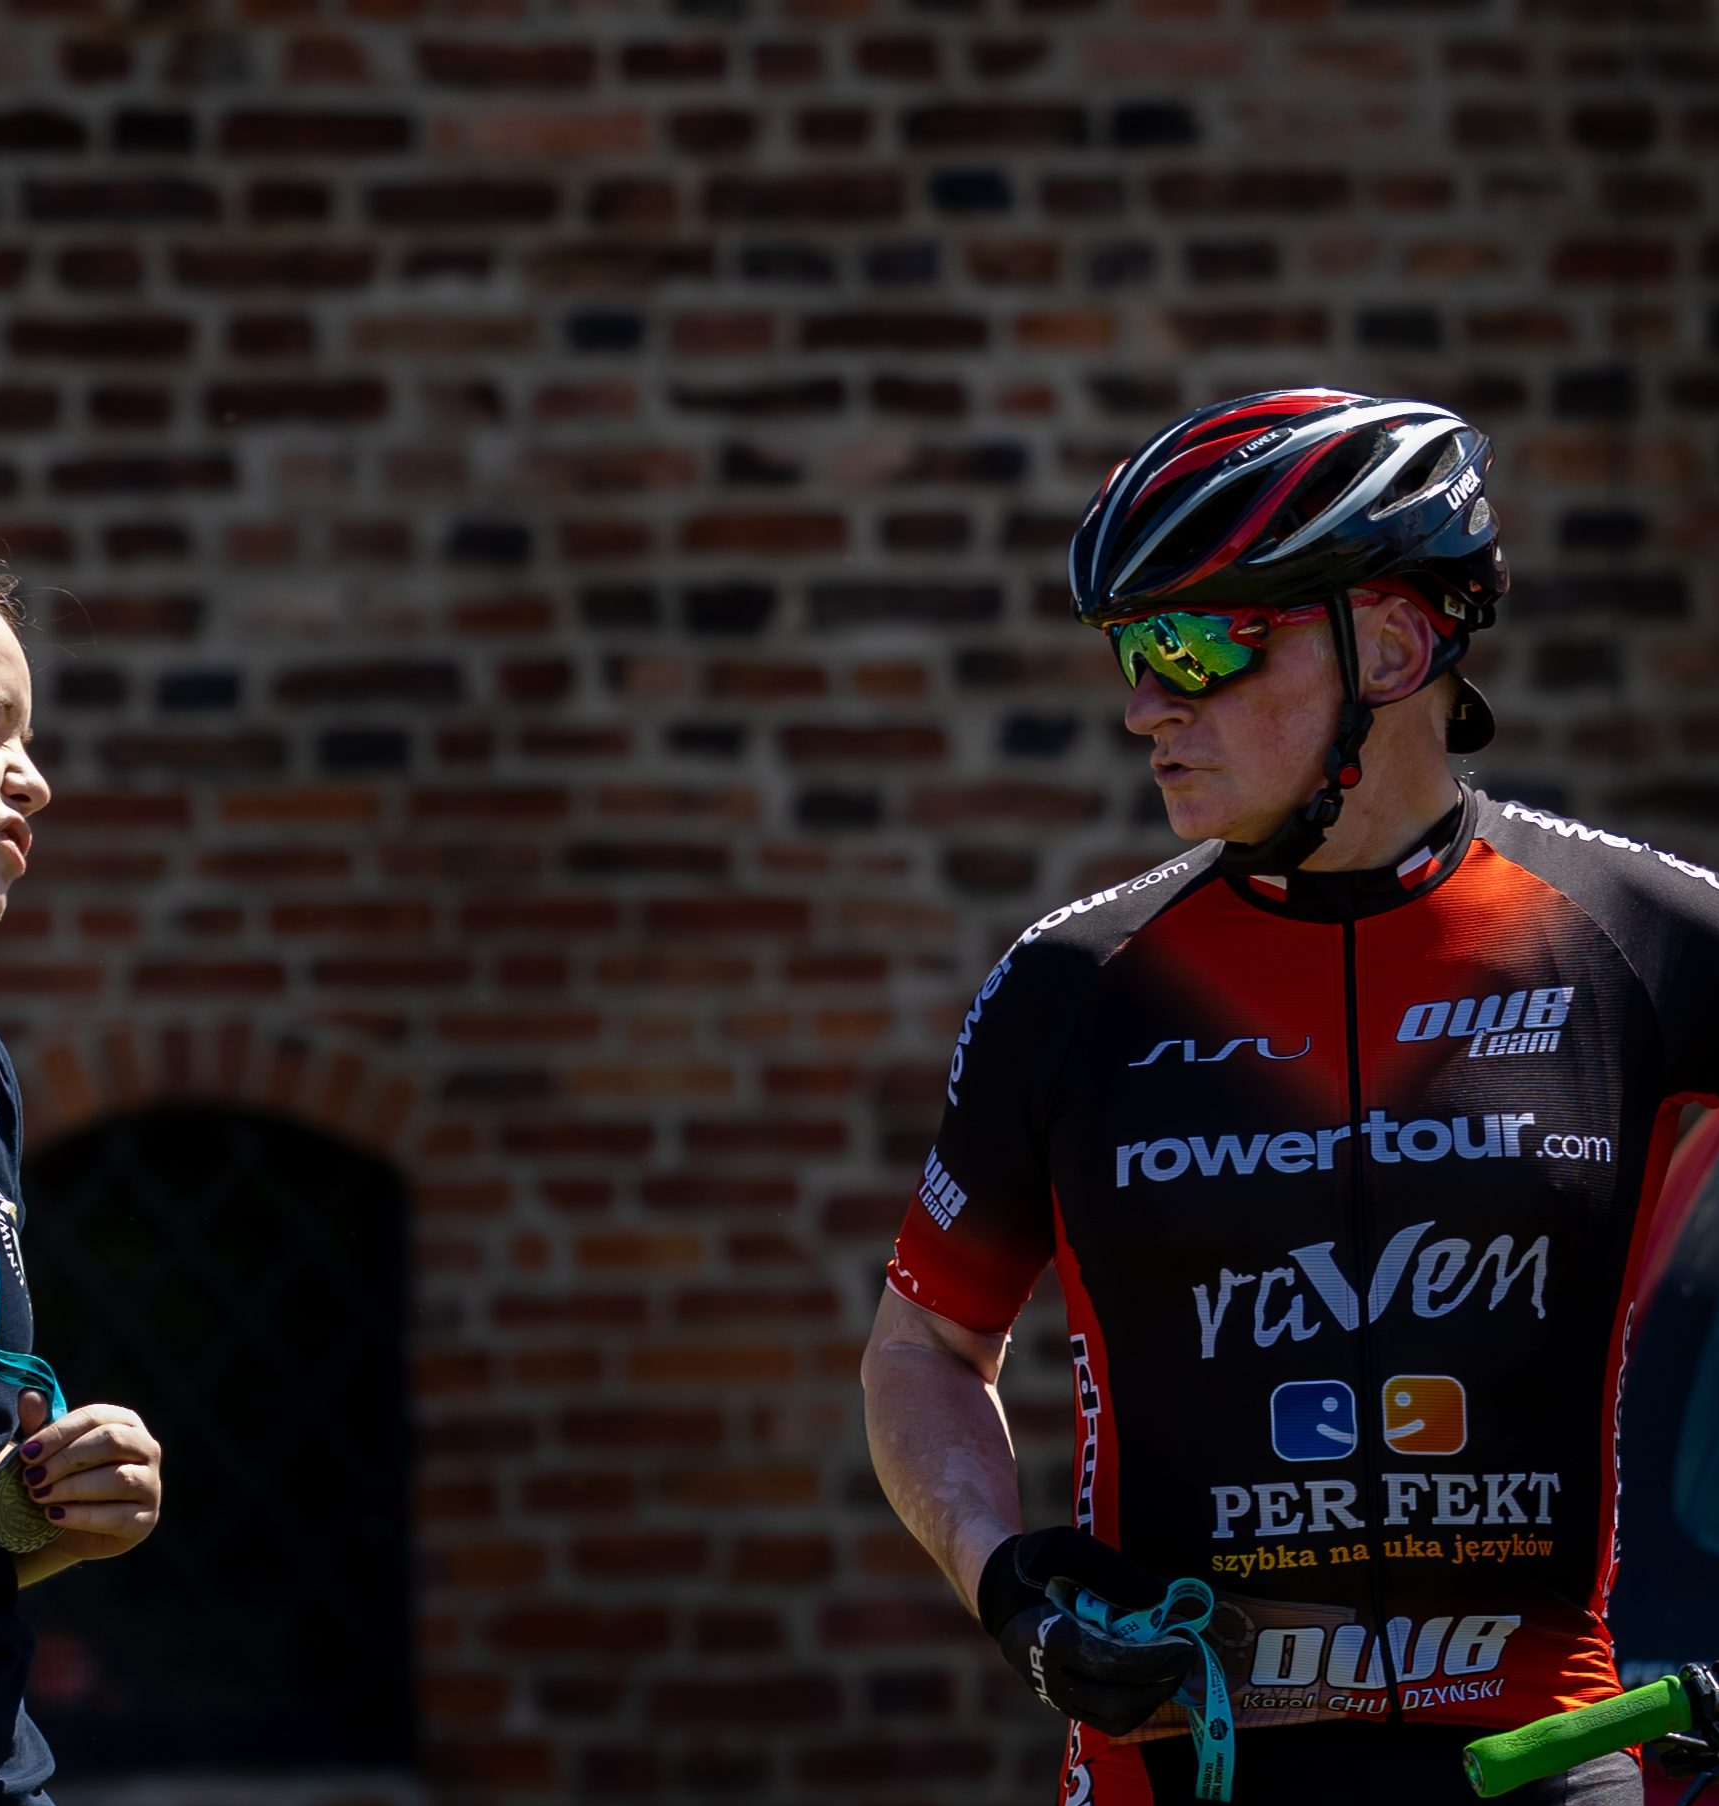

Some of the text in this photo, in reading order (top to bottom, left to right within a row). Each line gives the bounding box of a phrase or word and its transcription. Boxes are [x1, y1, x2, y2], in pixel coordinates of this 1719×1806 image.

[1443, 465, 1481, 511] uvex
[1394, 986, 1575, 1043] OWB
[1114, 1107, 1613, 1189] rowertour.com
[1211, 1544, 1318, 1578] szybka
[1451, 1532, 1554, 1565] języków
[1247, 1614, 1522, 1691] OWB
[1241, 1692, 1314, 1709] Karol
